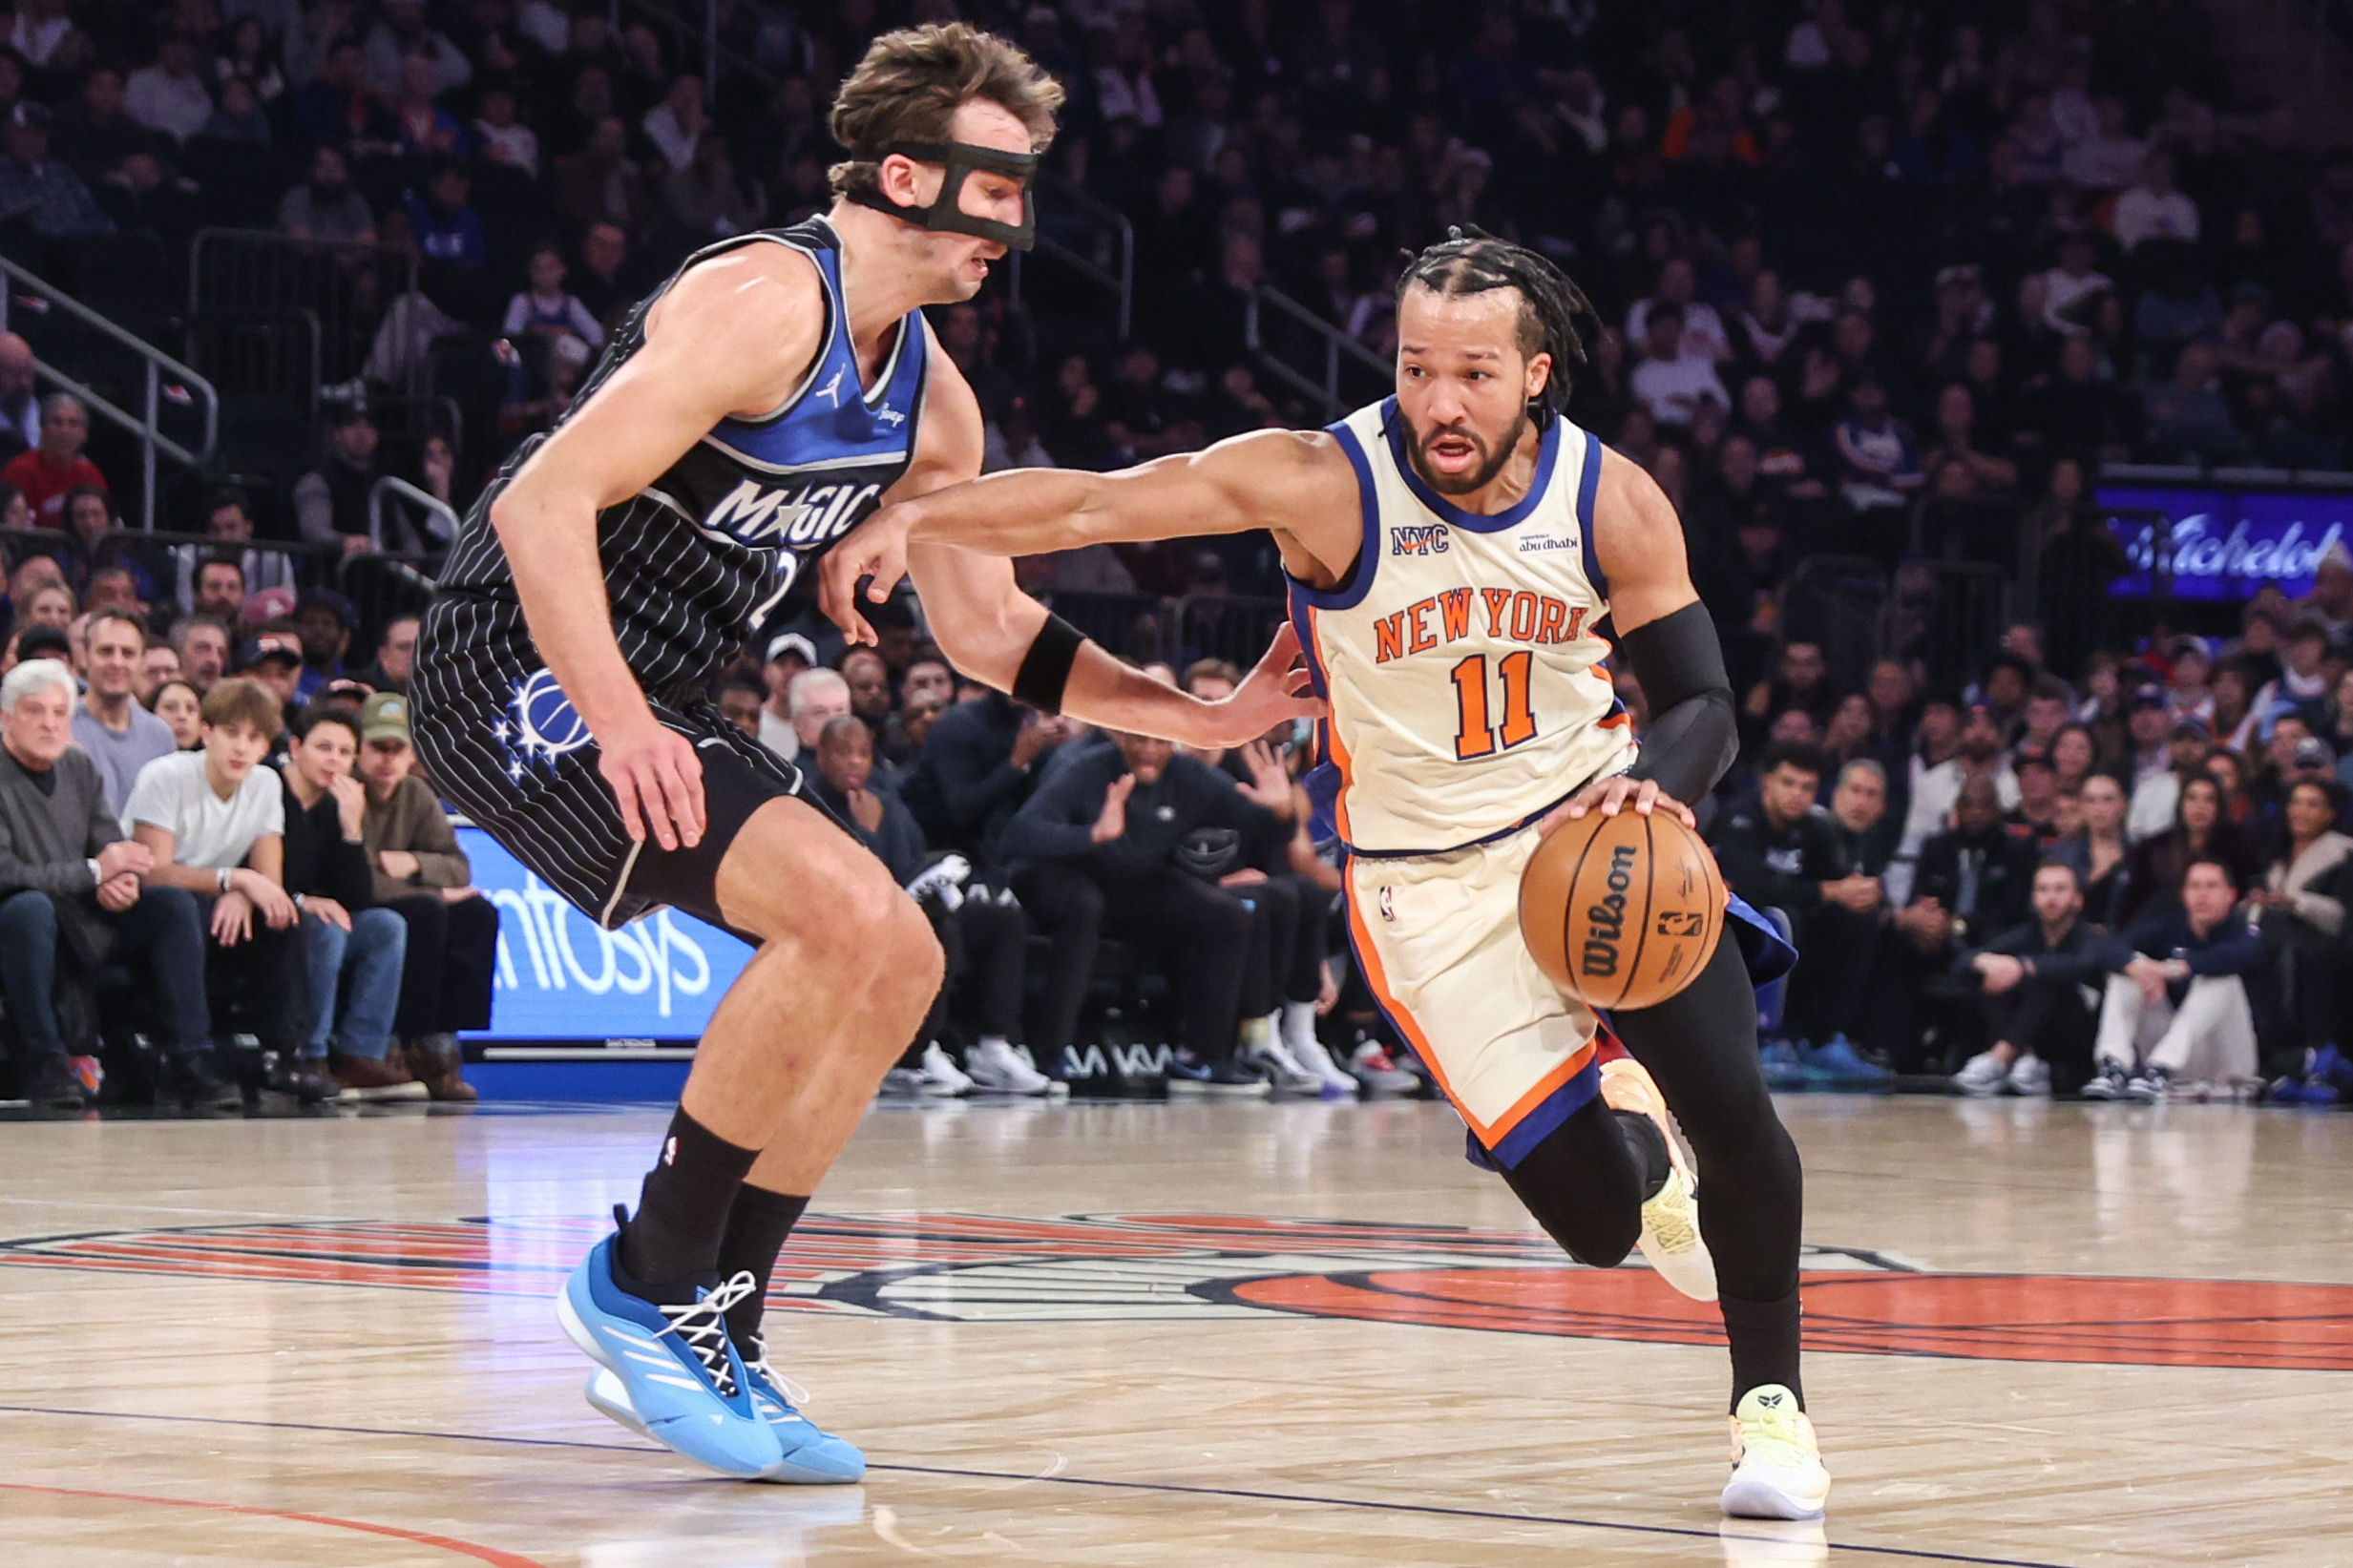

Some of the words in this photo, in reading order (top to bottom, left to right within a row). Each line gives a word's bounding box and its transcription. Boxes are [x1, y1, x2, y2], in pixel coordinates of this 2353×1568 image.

[1390, 523, 1449, 555] NYC
[1519, 540, 1542, 552] abu
[1543, 536, 1578, 550] dhabi
[1374, 586, 1474, 664] NEW
[1481, 587, 1589, 644] YORK
[1450, 650, 1539, 762] 11
[488, 869, 710, 1018] nfosys
[1582, 844, 1638, 977] Wilson
